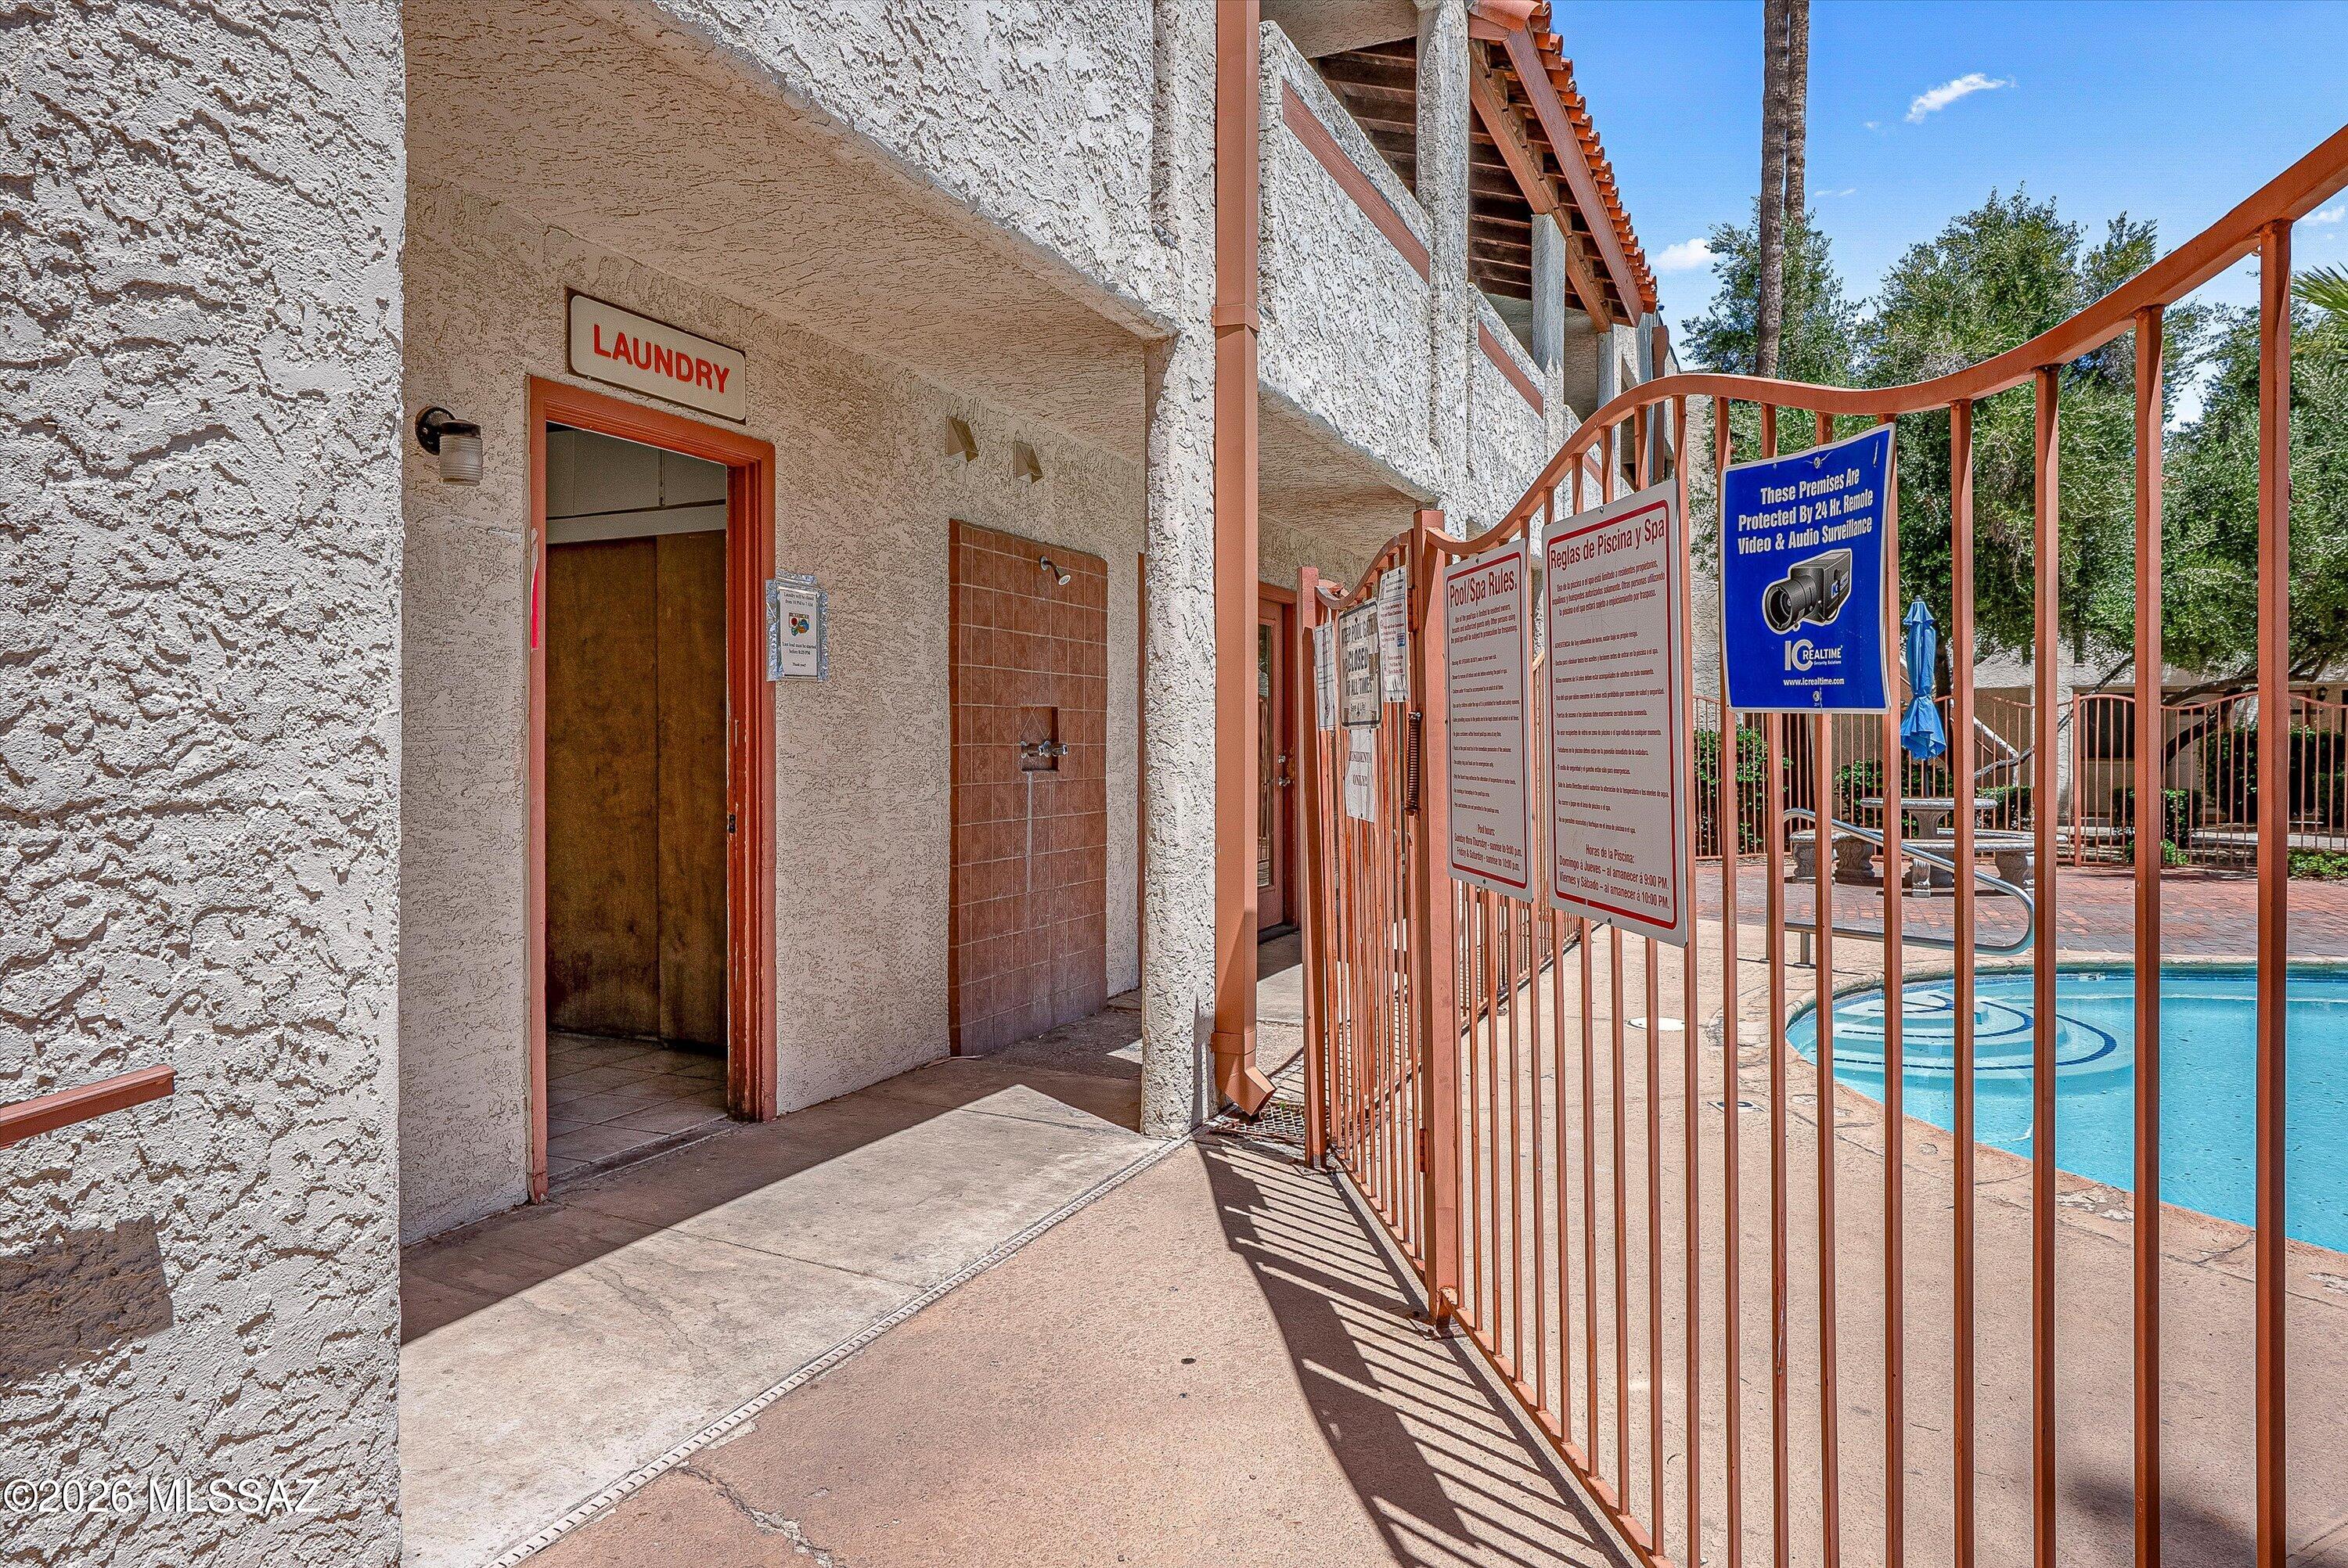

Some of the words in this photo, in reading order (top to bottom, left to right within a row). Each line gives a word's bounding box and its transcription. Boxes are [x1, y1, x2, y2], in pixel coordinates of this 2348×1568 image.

[593, 324, 729, 394] LAUNDRY
[1760, 486, 1795, 505] These
[1799, 475, 1844, 499] Premises
[1846, 469, 1859, 488] Are
[1738, 506, 1795, 531] Protected
[1800, 505, 1813, 525] By
[1816, 501, 1828, 519] 24
[1830, 498, 1841, 517] Hr.
[1844, 489, 1873, 514] Remote
[1550, 545, 1580, 571] Reglas
[1583, 539, 1594, 560] de
[1636, 527, 1641, 550] y
[1644, 519, 1664, 545] Spa
[1738, 536, 1771, 555] Video
[1775, 534, 1784, 550] &
[1788, 529, 1818, 549] Audio
[1822, 516, 1872, 544] Surveillance
[1450, 577, 1486, 608] Pool/Spa
[1489, 568, 1517, 596] Rules.
[1803, 648, 1841, 660] REALTIME
[1586, 843, 1600, 857] Horas
[1601, 847, 1607, 858] de
[1608, 847, 1613, 859] la
[1559, 855, 1579, 871] Domingo
[1584, 861, 1601, 874] Jueves
[1607, 865, 1612, 876] al
[1612, 869, 1638, 883] amanecer
[1644, 873, 1656, 887] 9:00
[1658, 876, 1669, 890] PM.
[1560, 871, 1576, 885] Viernes
[1581, 876, 1598, 890] Sábado
[1604, 883, 1609, 893] al
[1611, 886, 1636, 900] amanecer
[1642, 891, 1657, 906] 10:00
[1658, 895, 1669, 909] PM.
